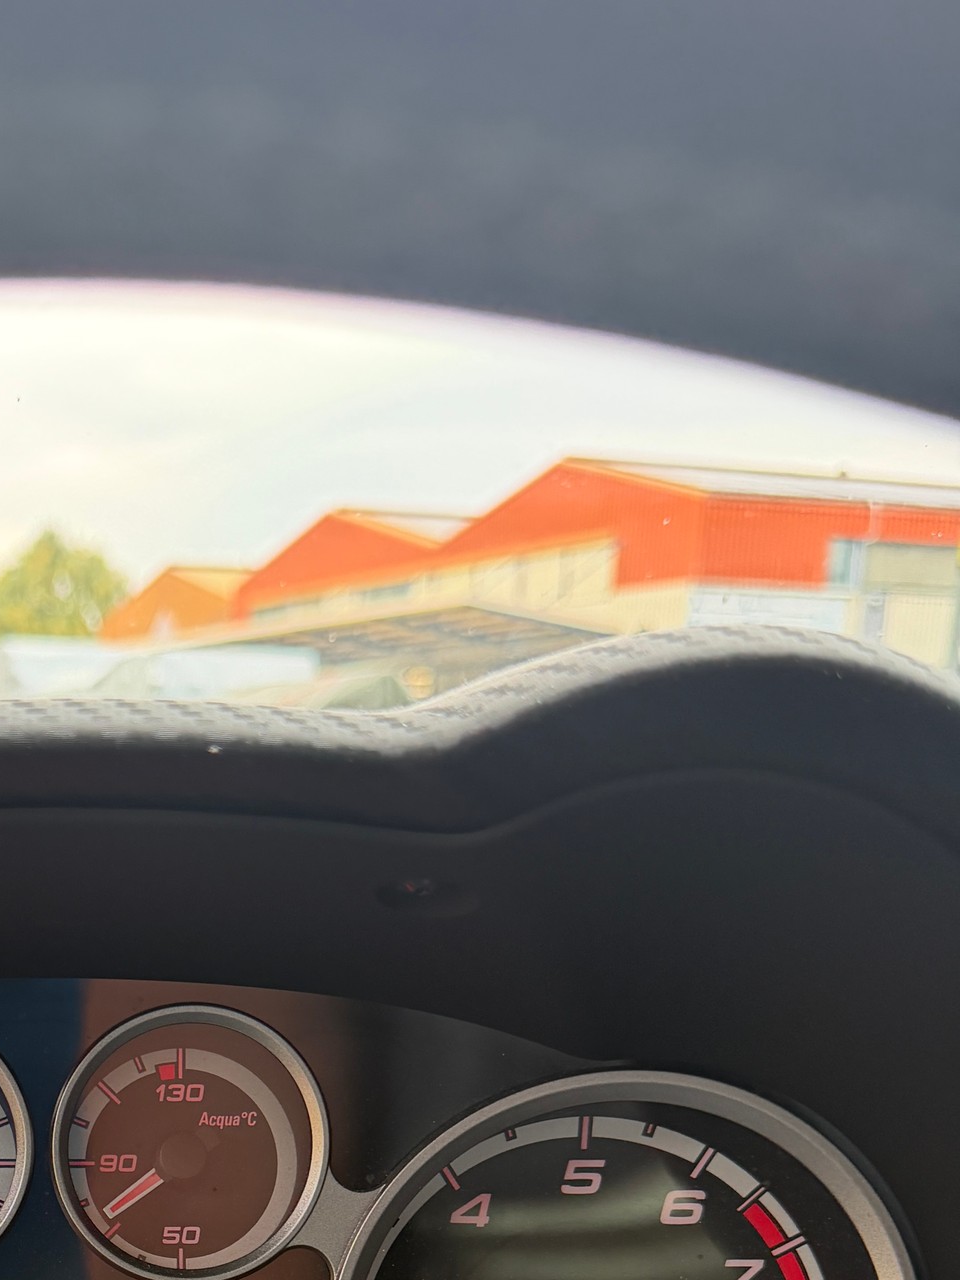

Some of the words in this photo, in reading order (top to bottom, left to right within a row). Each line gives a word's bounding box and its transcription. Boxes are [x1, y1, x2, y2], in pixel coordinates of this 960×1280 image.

[155, 1083, 205, 1102] 130
[99, 1154, 137, 1173] 90
[560, 1160, 606, 1195] 5
[450, 1193, 492, 1227] 4
[660, 1190, 706, 1225] 6
[162, 1226, 201, 1245] 50
